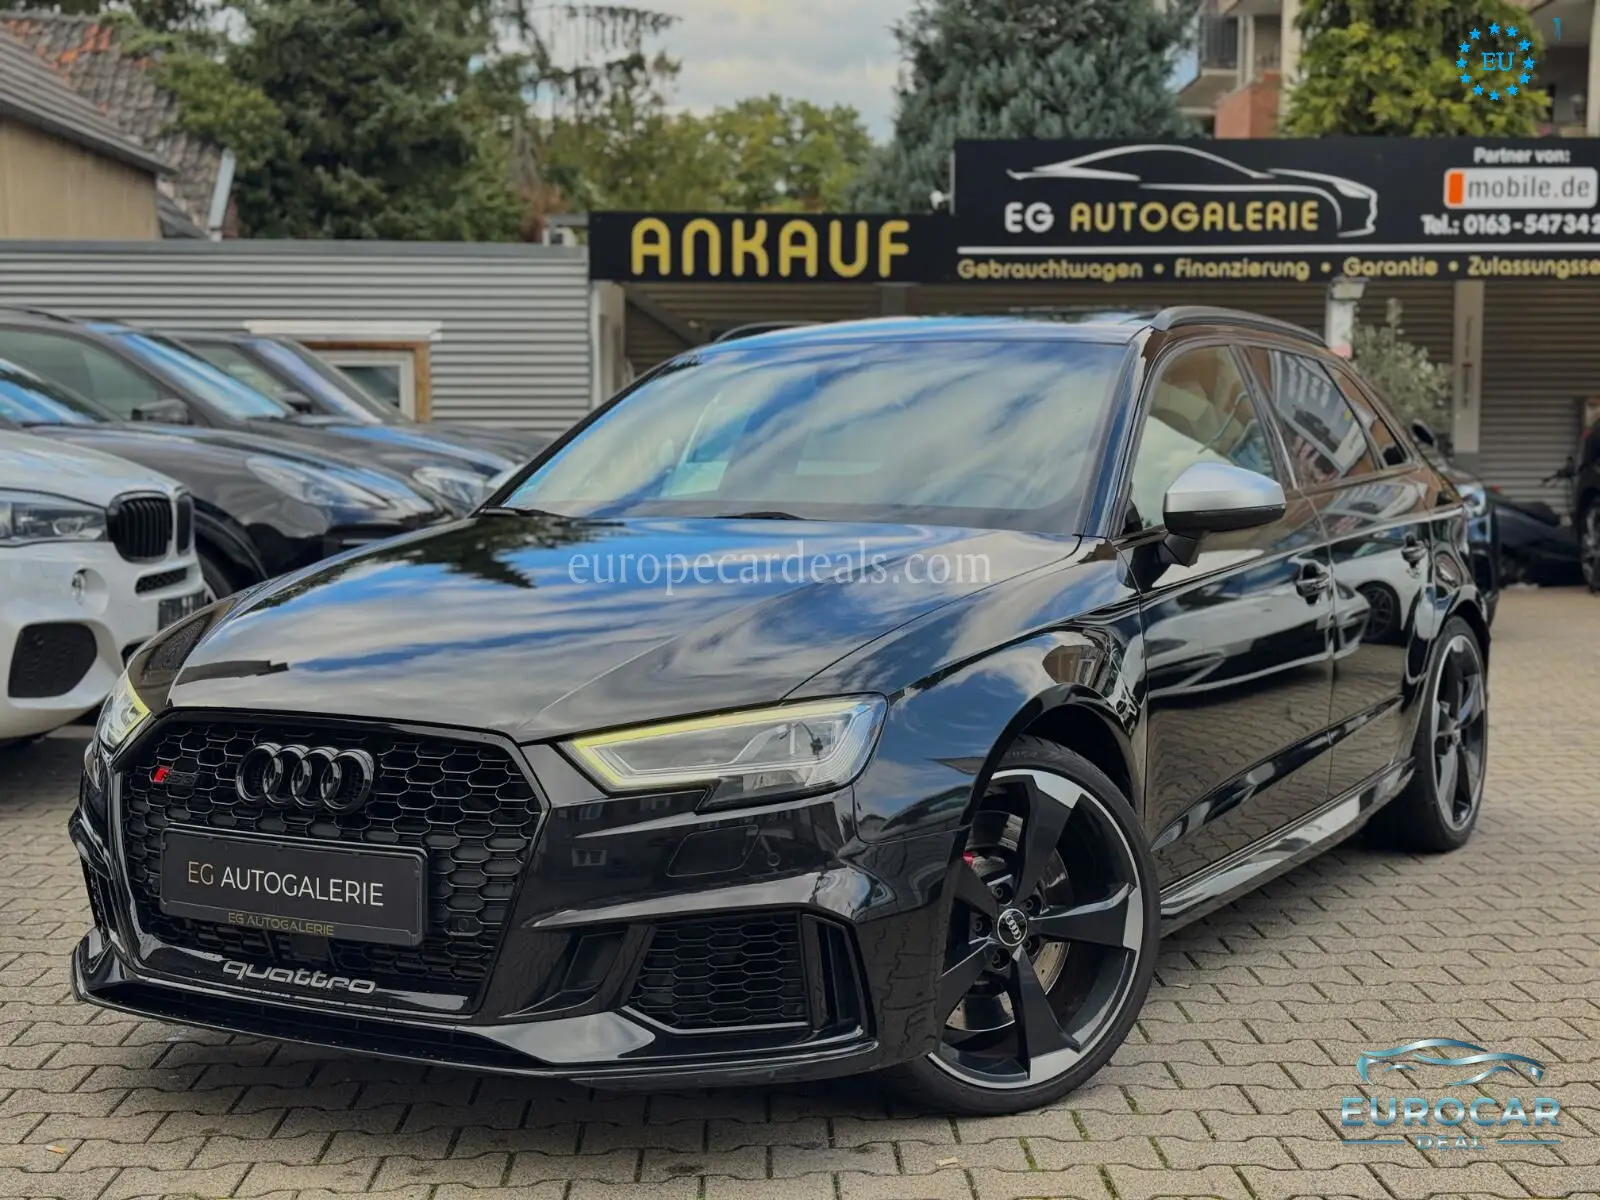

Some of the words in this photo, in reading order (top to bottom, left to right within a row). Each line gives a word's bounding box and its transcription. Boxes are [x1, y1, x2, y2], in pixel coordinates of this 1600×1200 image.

[1473, 146, 1532, 164] Partner
[1534, 150, 1571, 163] von:
[1468, 175, 1591, 198] mobile.de
[1004, 202, 1054, 232] EG
[1069, 201, 1319, 232] AUTOGALERIE
[1421, 214, 1460, 235] Tel.:
[631, 217, 910, 277] ANKAUF
[957, 259, 1143, 282] Gebrauchtwagen
[1174, 258, 1310, 281] Finanzierung
[1343, 257, 1438, 276] Garantie
[187, 861, 214, 885] EG
[220, 866, 384, 906] AUTOGALERIE
[228, 912, 244, 924] EG
[246, 914, 335, 936] AUTOGALERIE
[222, 960, 377, 994] quattro
